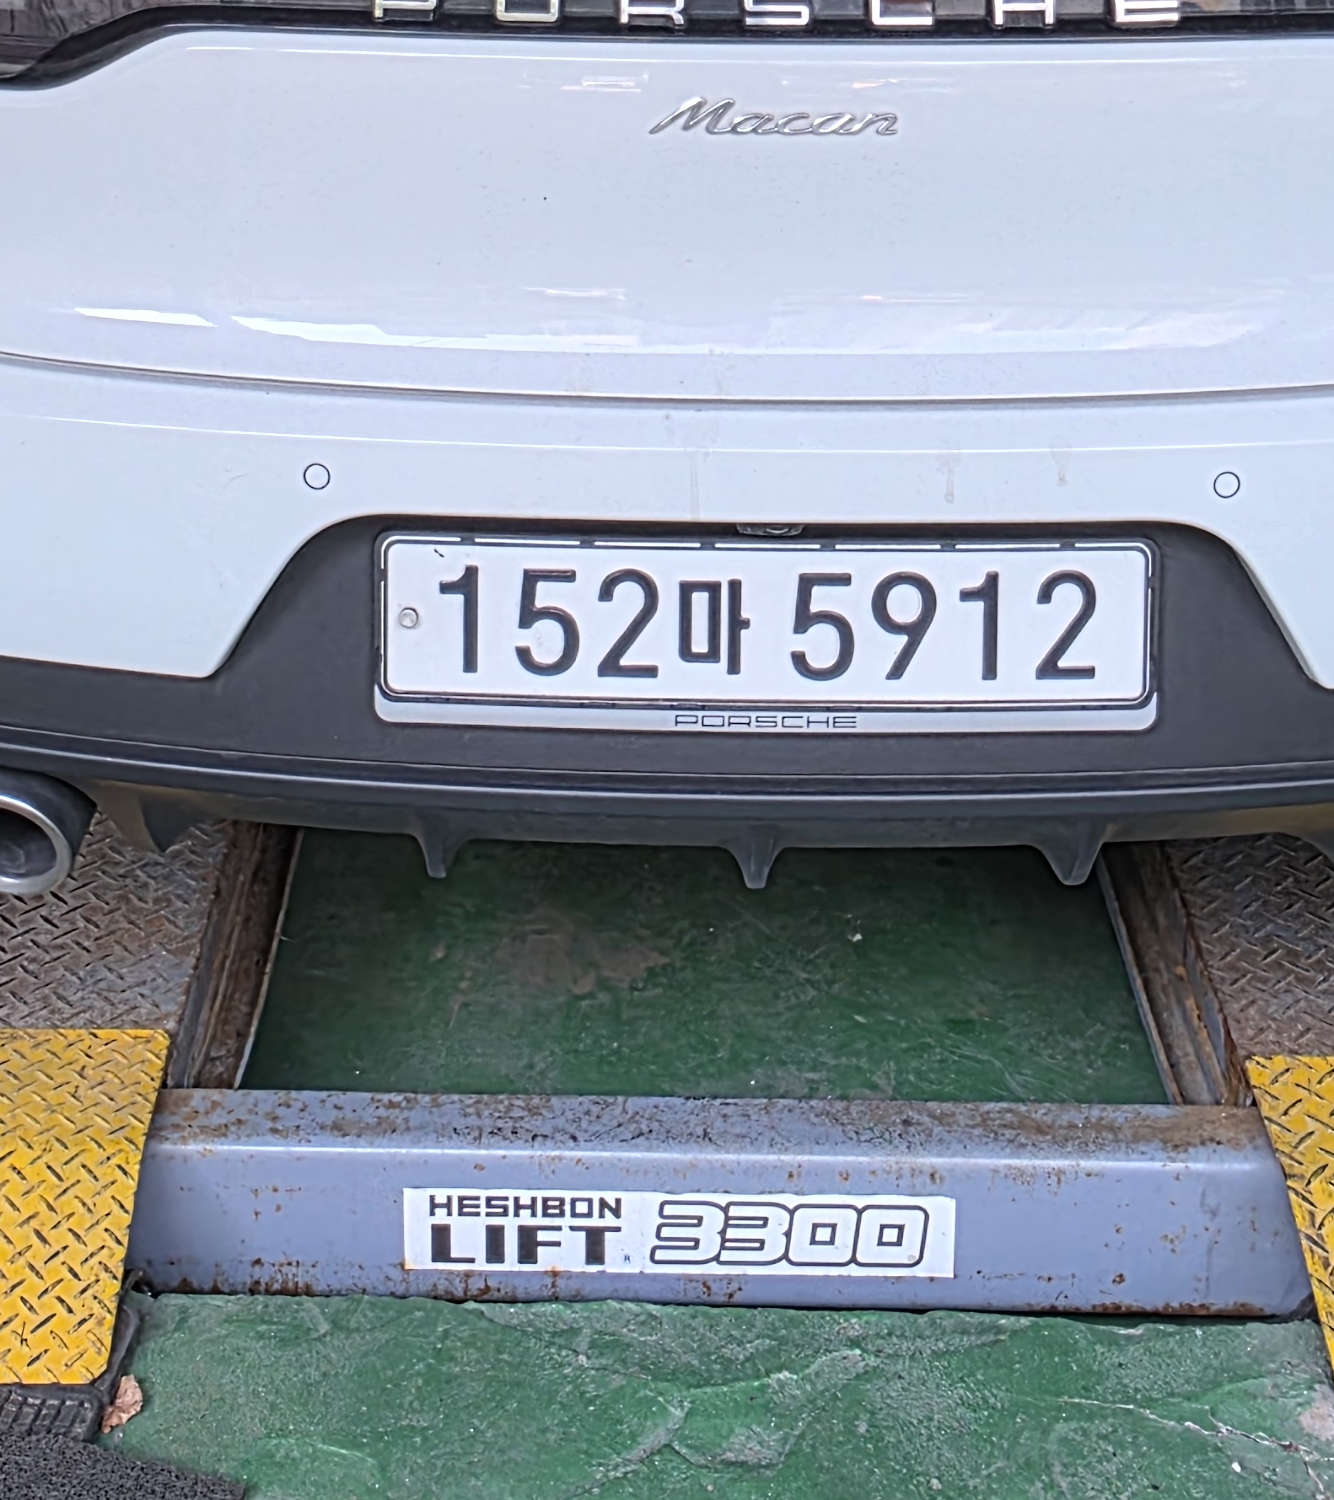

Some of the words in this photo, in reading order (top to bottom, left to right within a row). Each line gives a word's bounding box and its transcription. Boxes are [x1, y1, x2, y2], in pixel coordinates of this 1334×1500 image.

[648, 97, 899, 137] Macan
[438, 563, 751, 679] 152마
[789, 568, 1097, 682] 5912
[673, 713, 858, 730] PORSCHE
[428, 1193, 623, 1219] HESHBON
[430, 1222, 622, 1266] LIFT
[649, 1200, 930, 1269] 3300
